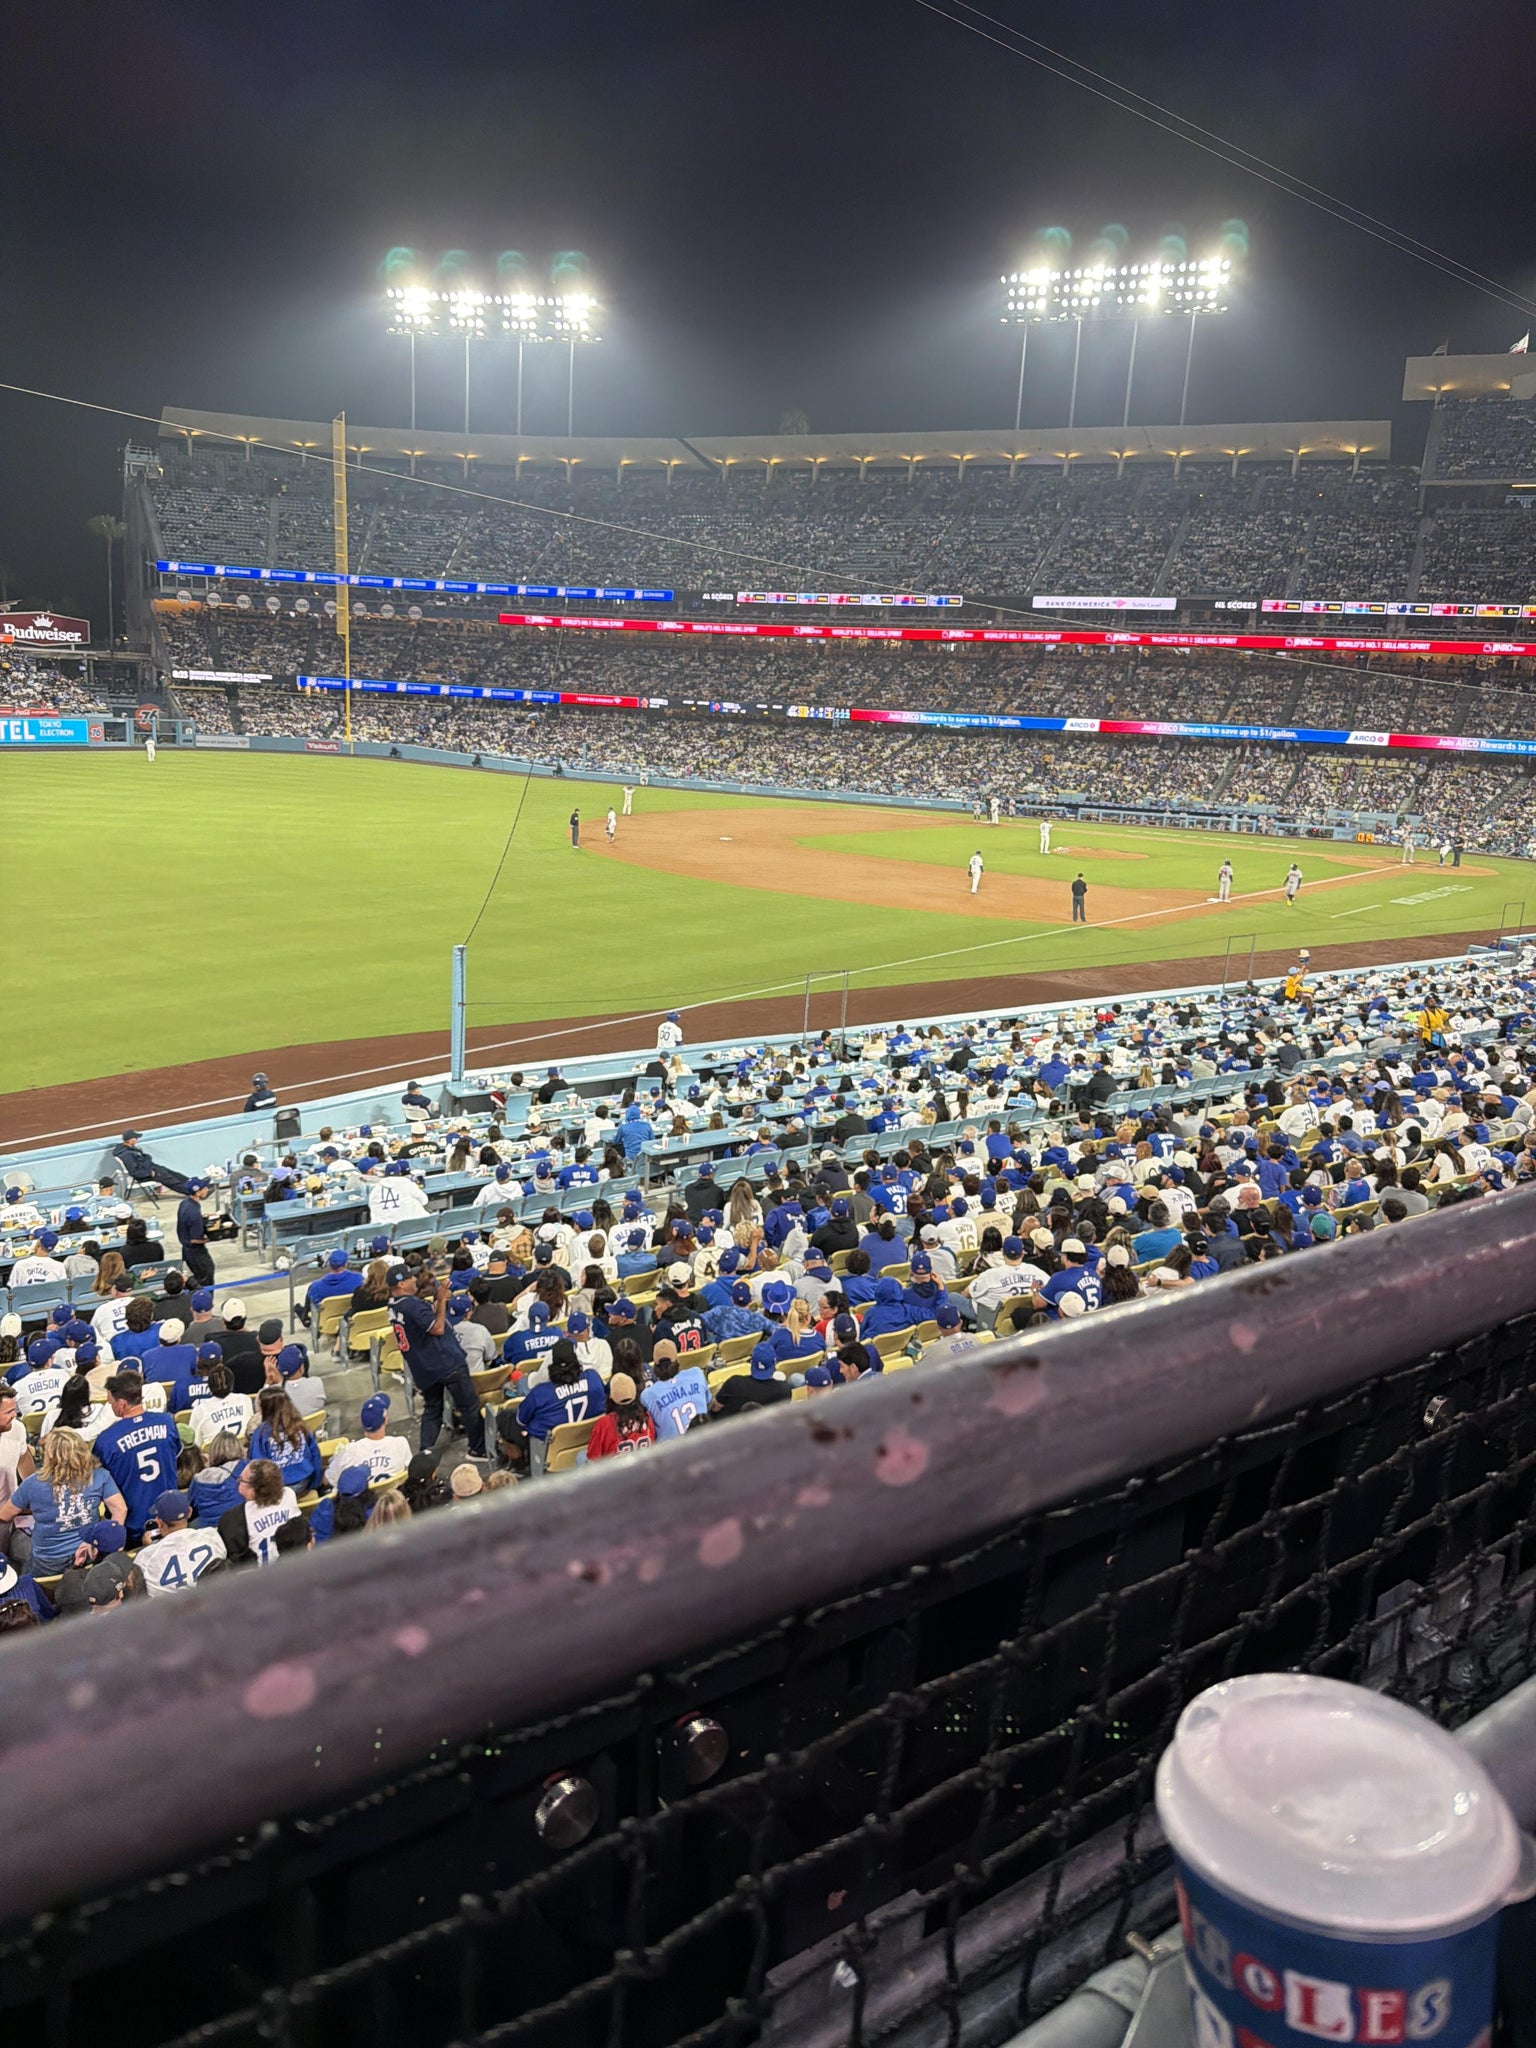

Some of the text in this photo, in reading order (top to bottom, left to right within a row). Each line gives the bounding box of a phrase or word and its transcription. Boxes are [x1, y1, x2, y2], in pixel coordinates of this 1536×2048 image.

[1492, 644, 1513, 652] JINRO
[138, 710, 158, 724] 76
[90, 727, 102, 738] 76
[1179, 726, 1210, 734] Rewards
[1260, 729, 1298, 738] $1/gallon.
[307, 742, 339, 750] Yakult
[1480, 741, 1516, 750] Rewards
[660, 1030, 670, 1041] 00
[380, 1186, 400, 1210] LA
[1086, 1287, 1099, 1312] 5
[112, 1308, 124, 1317] BE
[112, 1320, 128, 1331] 5
[678, 1330, 701, 1353] 13
[66, 1358, 76, 1368] OH
[28, 1379, 60, 1394] GIBSON
[188, 1384, 212, 1396] OHTA
[555, 1379, 588, 1400] OHTANI
[211, 1405, 244, 1423] OHTANI
[564, 1397, 588, 1423] 17
[117, 1425, 167, 1453] FREEMAN
[137, 1447, 160, 1482] 5
[254, 1509, 290, 1533] OHTANI
[160, 1544, 212, 1588] 42
